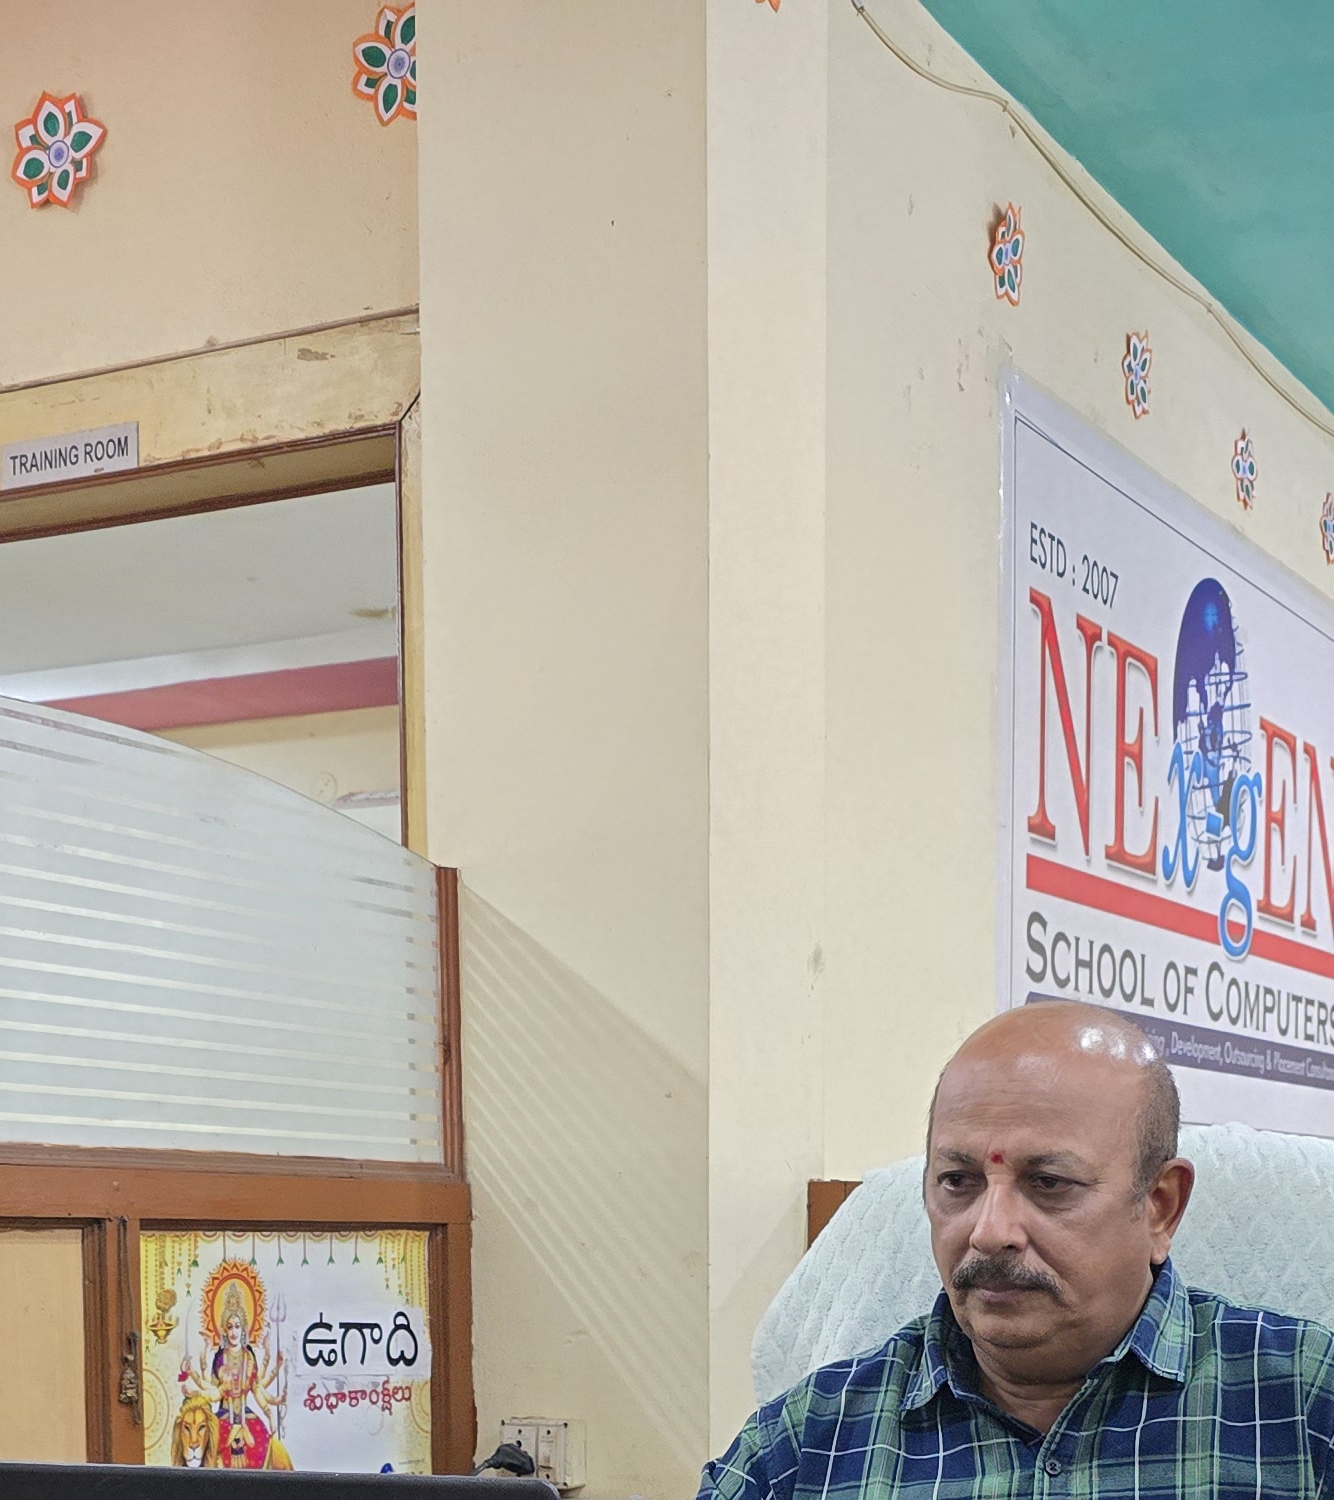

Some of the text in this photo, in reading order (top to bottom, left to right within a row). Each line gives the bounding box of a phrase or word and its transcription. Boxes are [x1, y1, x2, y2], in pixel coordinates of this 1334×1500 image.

[10, 436, 129, 476] TRAINING ROOM
[1029, 521, 1067, 579] ESTD
[1081, 554, 1119, 609] 2007
[1025, 910, 1155, 1009] SCHOOL
[1163, 960, 1198, 1016] OF
[303, 1311, 418, 1367] ఉగాది
